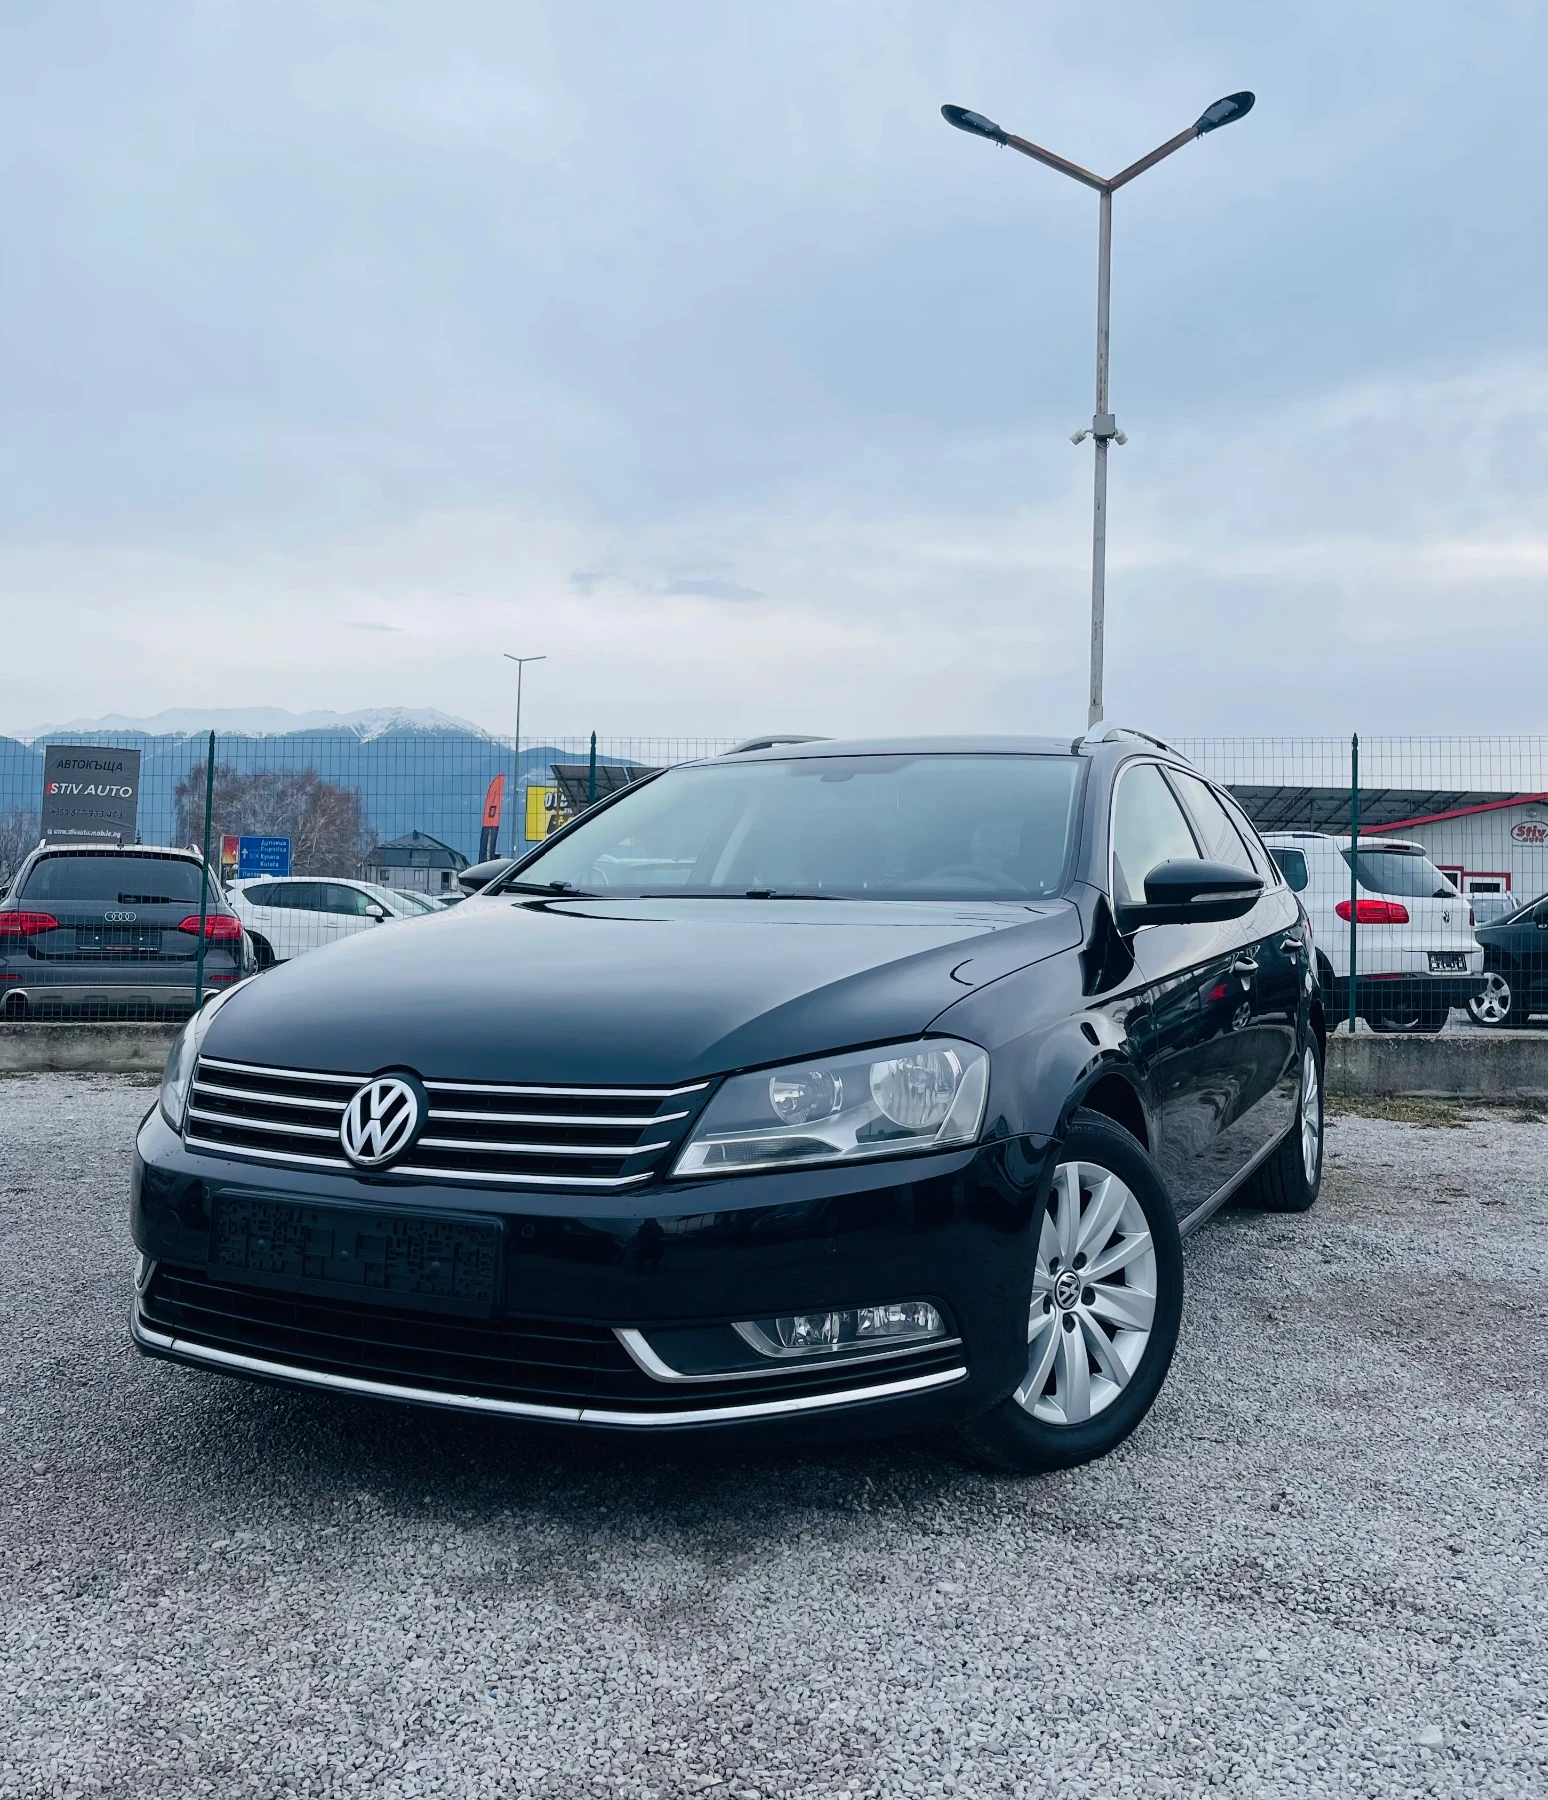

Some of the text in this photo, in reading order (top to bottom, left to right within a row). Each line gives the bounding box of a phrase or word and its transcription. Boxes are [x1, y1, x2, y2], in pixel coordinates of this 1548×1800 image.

[57, 759, 123, 773] АВТОКЪЩА
[50, 783, 133, 797] STIV AUTO
[1516, 825, 1547, 837] Stiv
